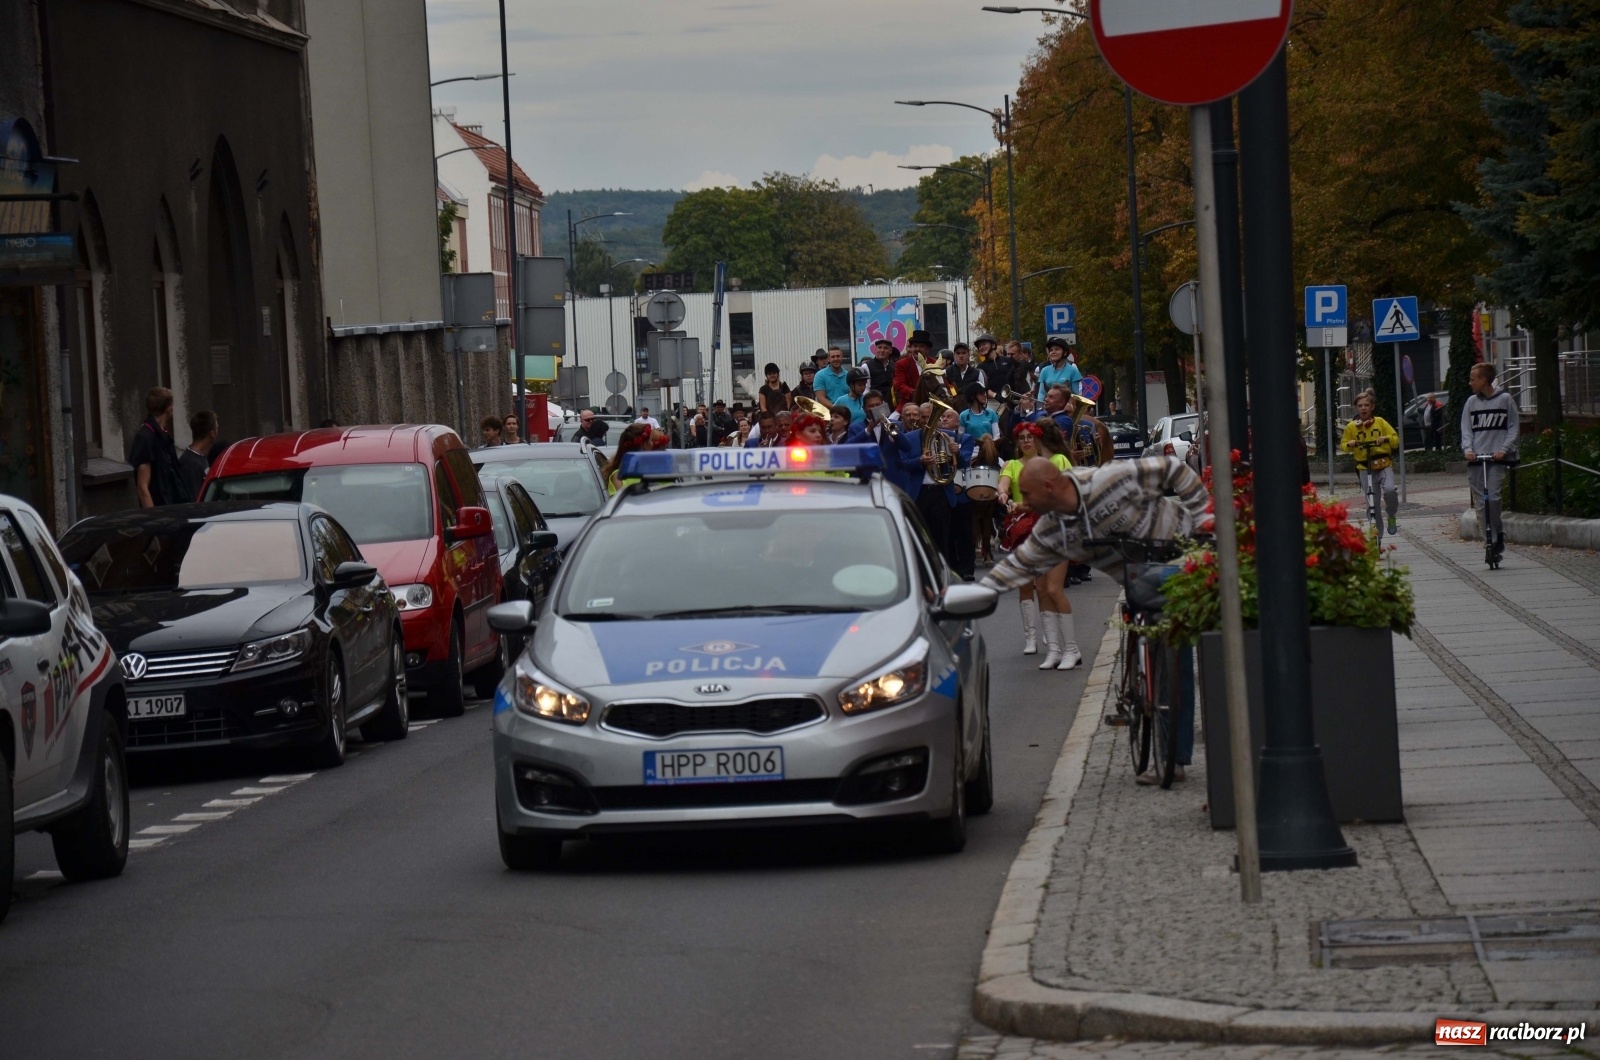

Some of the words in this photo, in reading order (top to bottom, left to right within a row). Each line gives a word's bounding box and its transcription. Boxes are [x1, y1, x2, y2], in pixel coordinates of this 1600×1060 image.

[5, 237, 36, 248] NIEBO
[1315, 290, 1338, 323] P
[1052, 307, 1069, 331] P
[698, 450, 780, 472] POLICJA
[645, 656, 787, 676] POLICJA
[700, 684, 725, 693] KIA
[145, 696, 182, 715] 1907
[661, 753, 706, 777] HPP
[716, 750, 776, 775] R006
